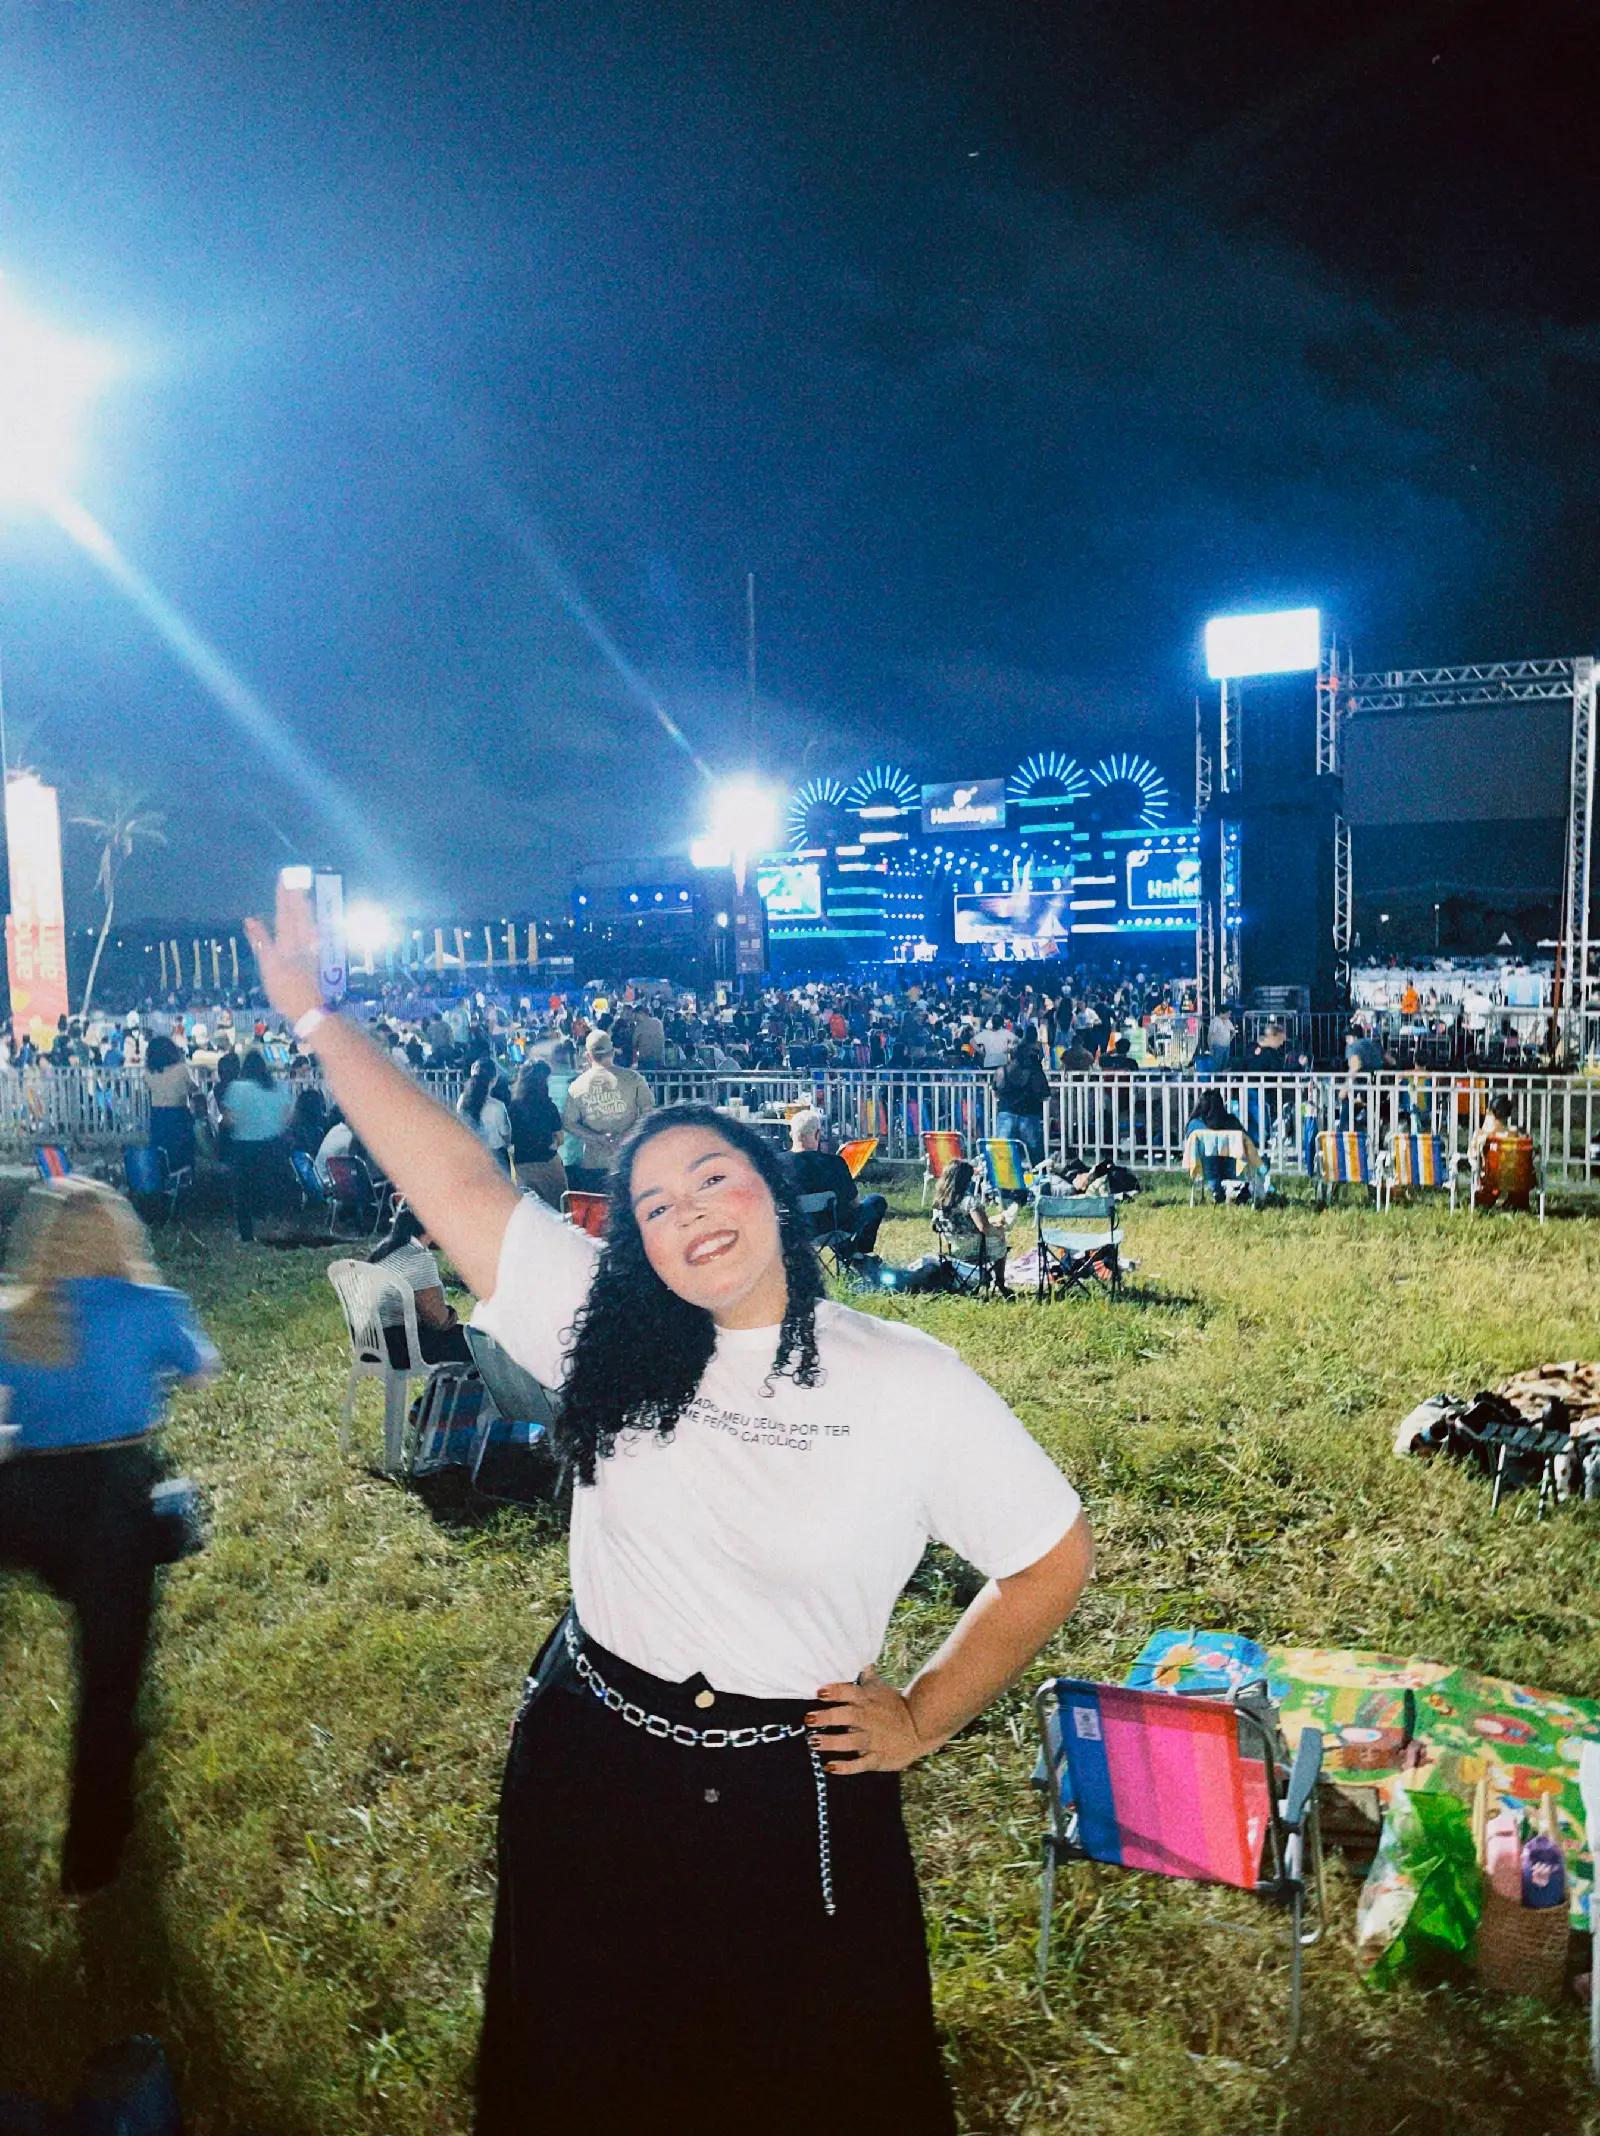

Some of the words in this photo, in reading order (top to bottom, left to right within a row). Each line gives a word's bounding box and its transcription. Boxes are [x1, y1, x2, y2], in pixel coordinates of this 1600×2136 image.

[703, 1414, 738, 1435] FEITO
[721, 1411, 750, 1426] MEU
[753, 1417, 786, 1433] DEUS
[790, 1423, 819, 1436] POR
[823, 1425, 850, 1437] TER
